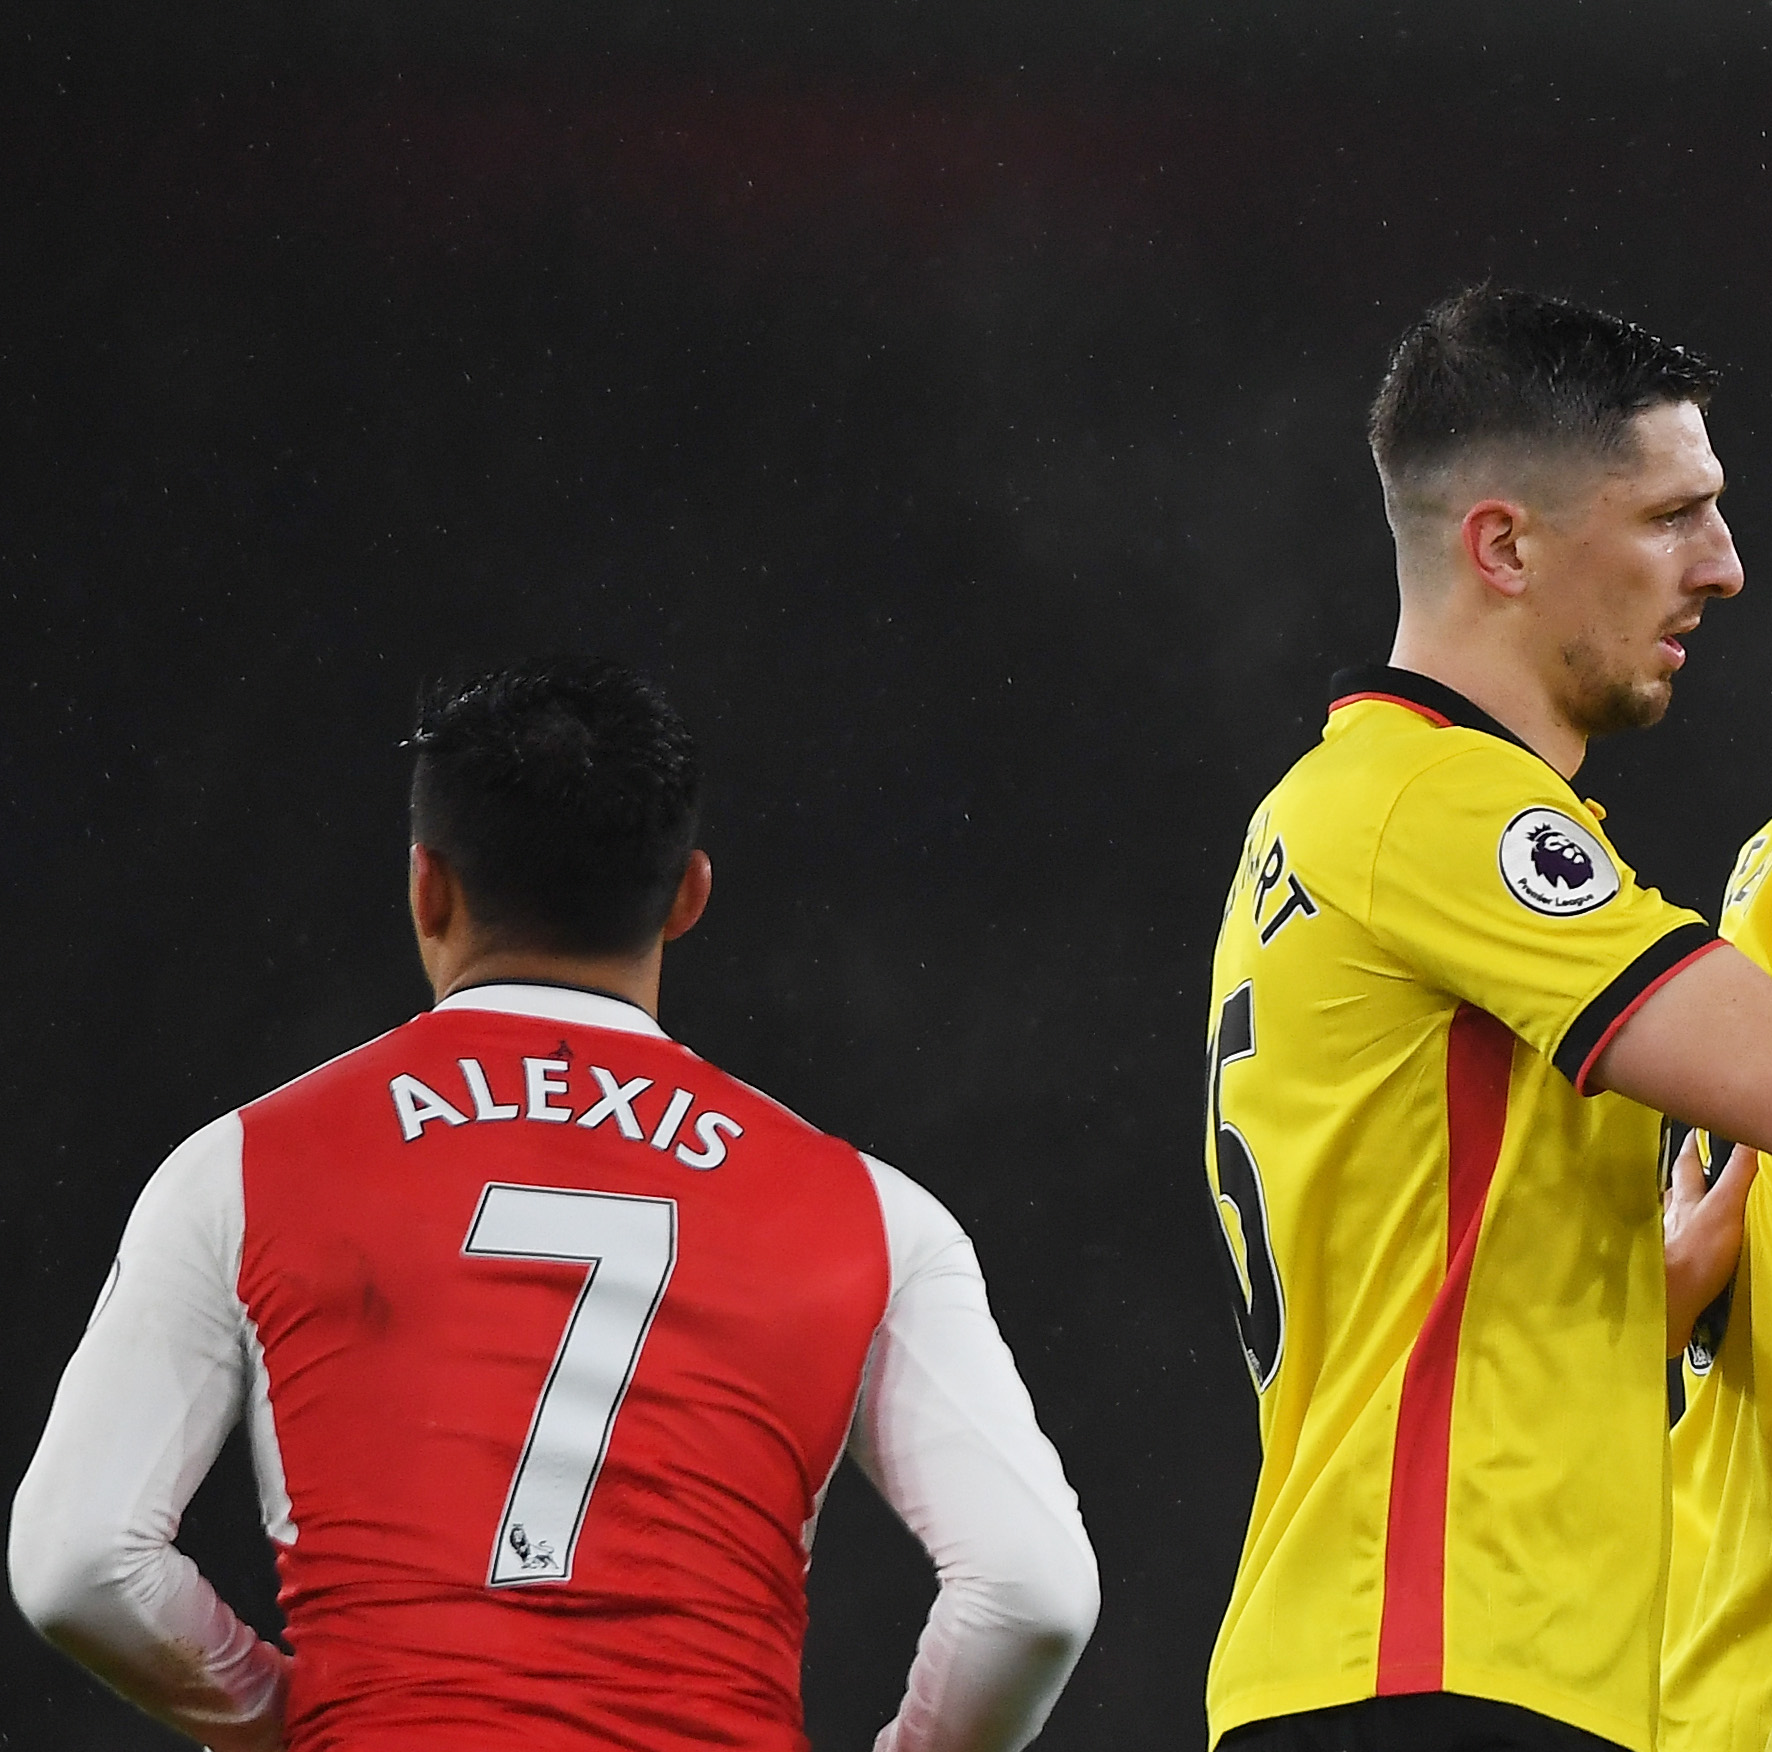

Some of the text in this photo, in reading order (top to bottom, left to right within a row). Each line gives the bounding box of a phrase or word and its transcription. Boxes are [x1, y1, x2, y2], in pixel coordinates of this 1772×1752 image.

[1517, 876, 1554, 906] Premier
[388, 1056, 744, 1172] ALEXIS
[460, 1180, 679, 1591] 7
